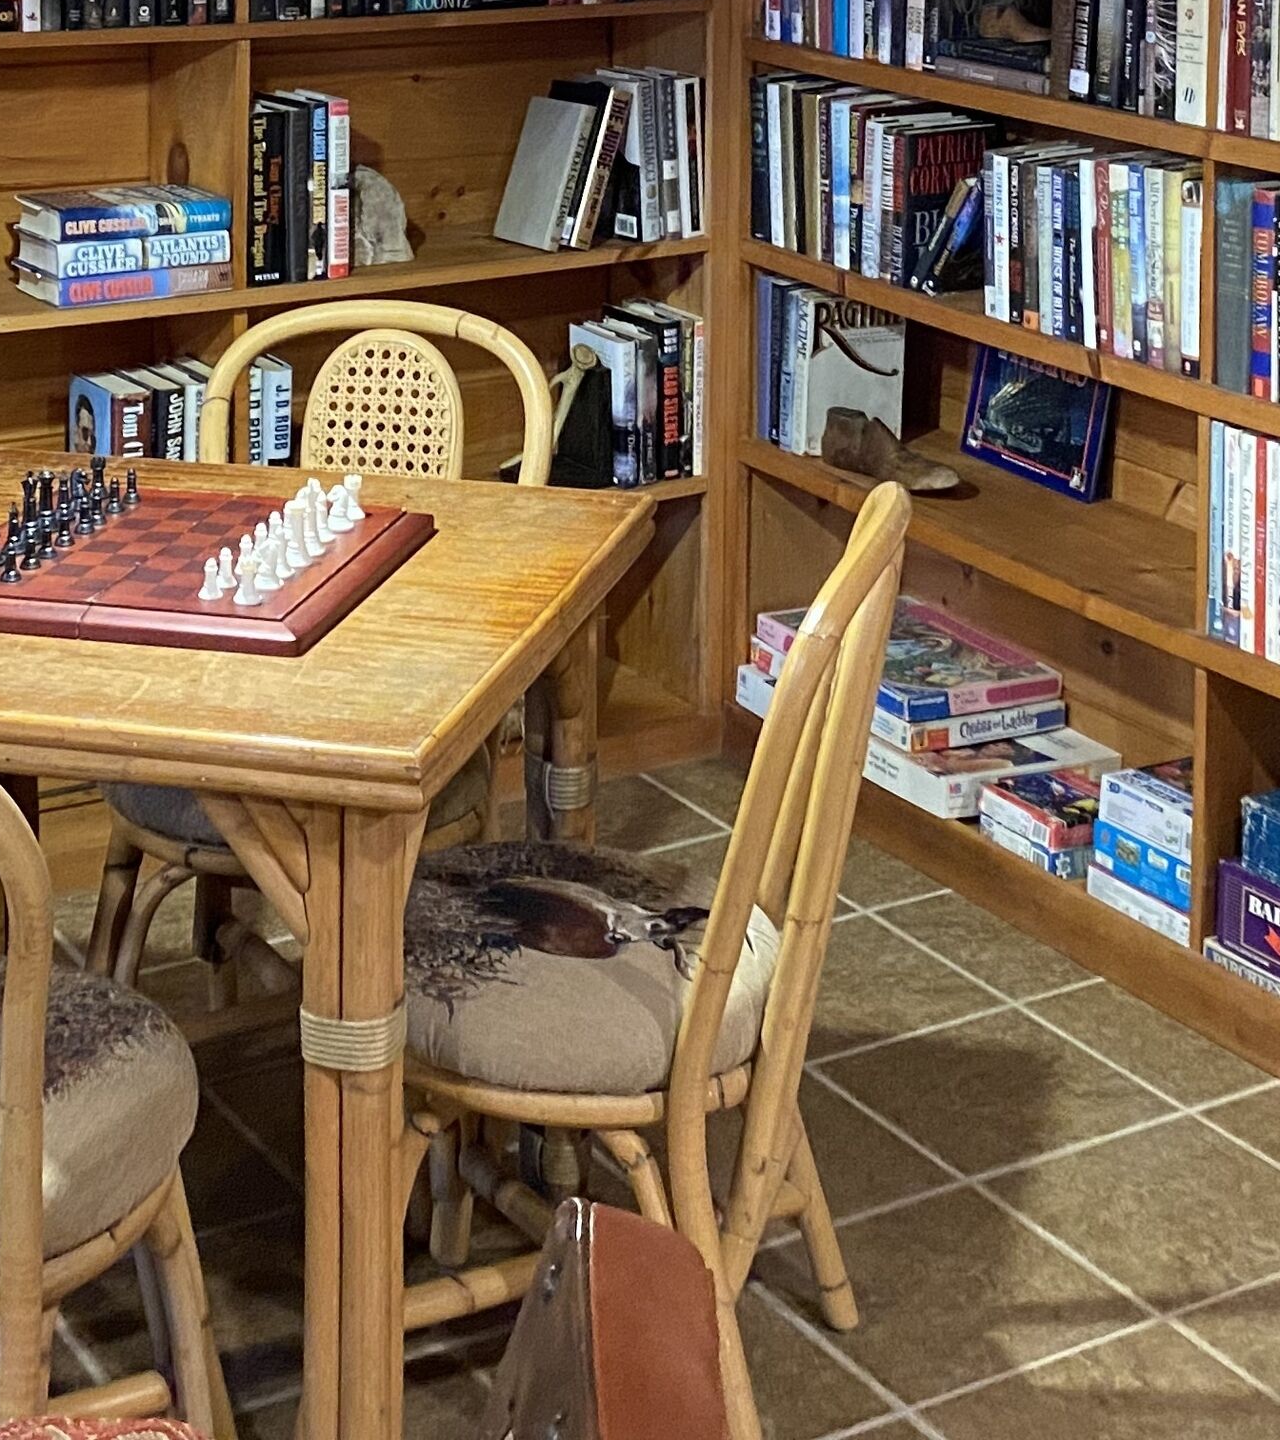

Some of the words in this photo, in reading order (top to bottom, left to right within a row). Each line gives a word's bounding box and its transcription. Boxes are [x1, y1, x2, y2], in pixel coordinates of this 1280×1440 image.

[1236, 19, 1246, 57] EYES
[608, 97, 629, 124] THE
[253, 117, 267, 140] The
[254, 141, 266, 170] Bear
[595, 128, 622, 171] JUDGE
[267, 157, 281, 180] Tom
[254, 174, 267, 195] and
[1053, 174, 1062, 199] JULIE
[254, 198, 267, 222] The
[266, 184, 281, 225] Clancy
[1053, 201, 1063, 230] SMITH
[65, 220, 97, 235] CLIVE
[98, 217, 147, 232] CUSSLER
[77, 243, 125, 260] CLIVE
[151, 236, 219, 255] ATLANTIS
[163, 249, 209, 267] FOUND
[251, 224, 267, 268] Dragon
[1256, 230, 1268, 263] TOM
[66, 257, 136, 277] CUSSLER
[1053, 245, 1062, 278] HOUSE
[69, 283, 101, 302] CLIVE
[103, 276, 154, 297] CUSSLER
[1053, 281, 1062, 295] OF
[1255, 269, 1269, 338] BROKAW
[796, 300, 808, 360] RAGTIME
[274, 384, 289, 396] J.
[123, 402, 144, 438] Tom
[167, 393, 184, 434] JOHN
[275, 400, 289, 413] D.
[274, 415, 289, 451] ROBB
[663, 398, 678, 445] SILENCE
[1241, 487, 1253, 557] GARDEN
[1267, 500, 1277, 517] The
[1240, 561, 1252, 605] STYLE
[1267, 570, 1276, 607] Country
